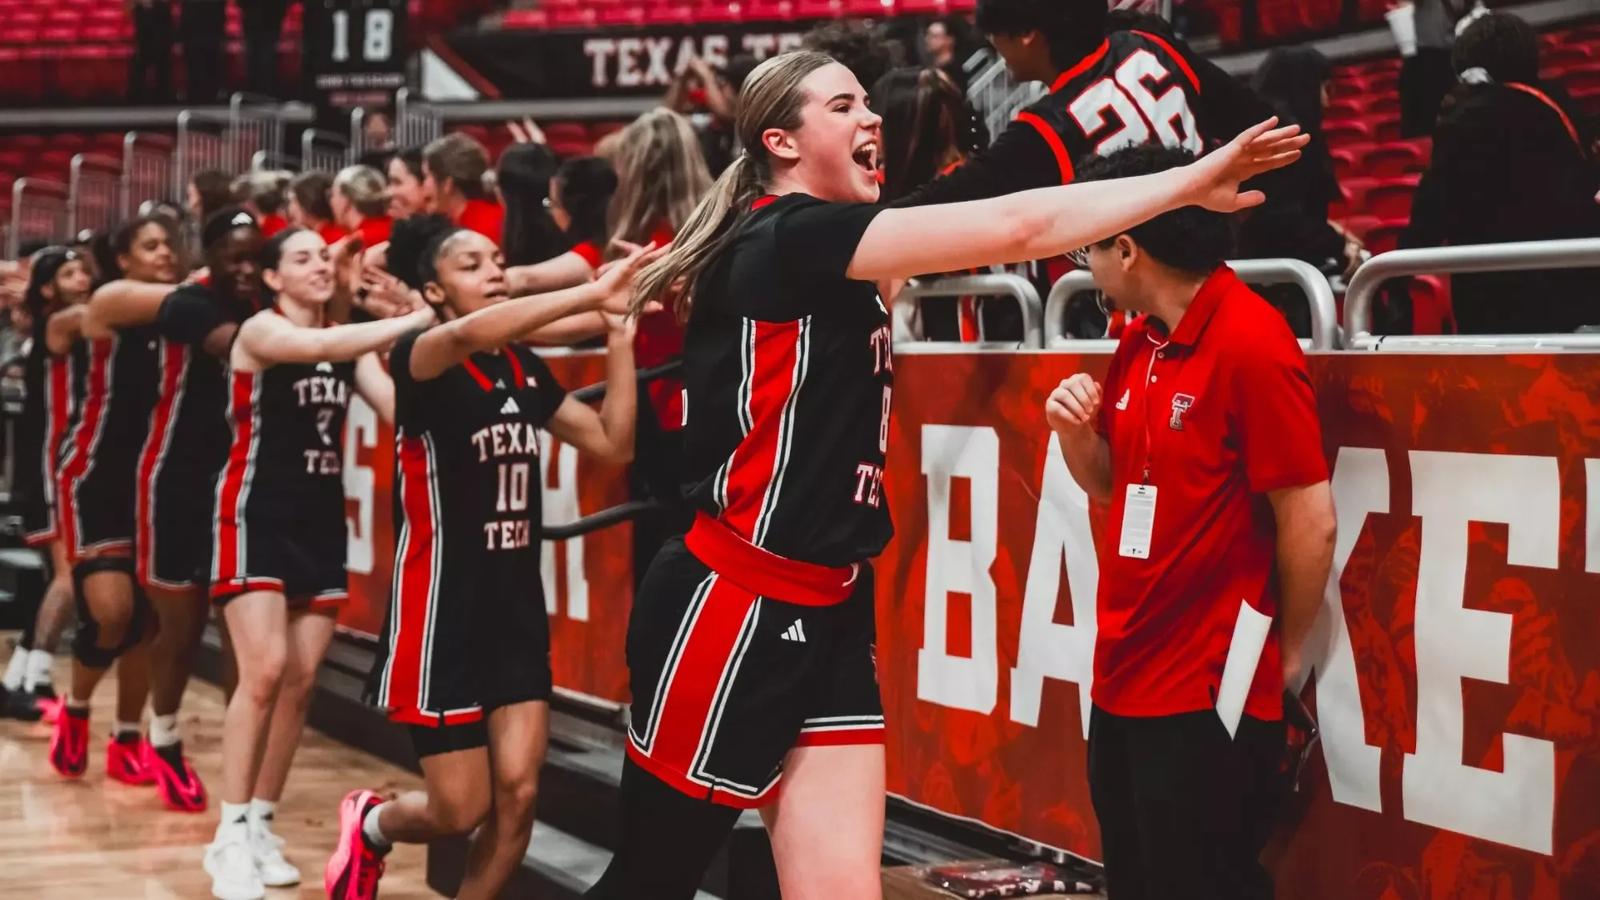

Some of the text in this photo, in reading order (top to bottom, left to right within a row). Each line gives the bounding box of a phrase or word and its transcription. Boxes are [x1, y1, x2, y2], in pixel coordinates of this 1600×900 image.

[331, 9, 394, 62] 18
[1067, 48, 1203, 156] 26
[292, 376, 347, 406] TEXA
[471, 422, 541, 462] TEXA
[496, 463, 530, 512] 10
